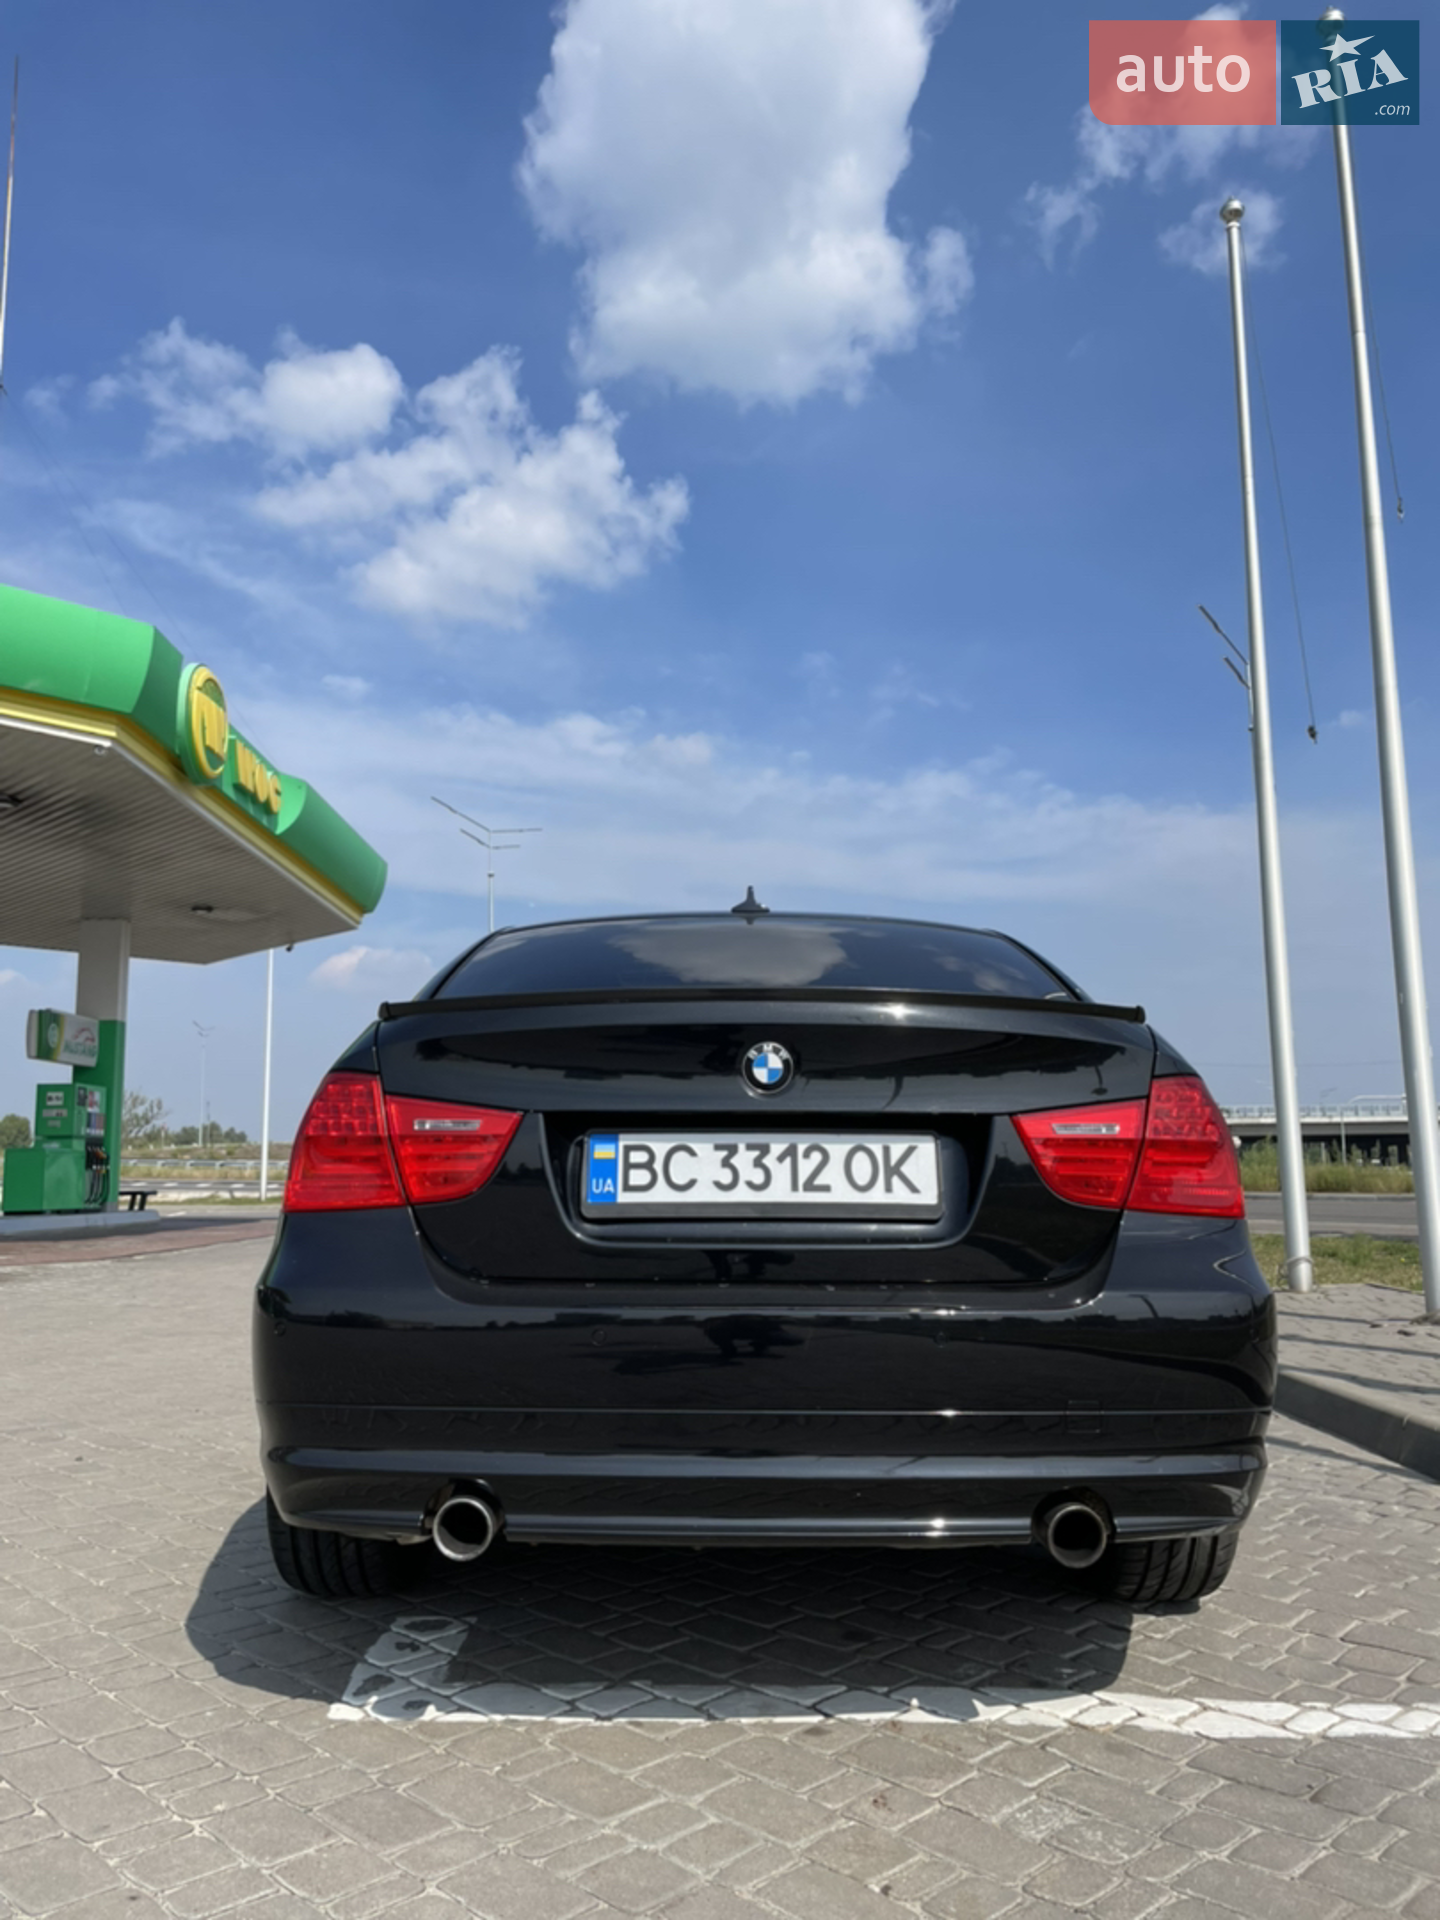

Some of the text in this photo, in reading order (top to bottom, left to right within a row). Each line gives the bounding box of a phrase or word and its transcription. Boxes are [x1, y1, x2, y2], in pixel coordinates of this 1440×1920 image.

[237, 741, 281, 814] WOG
[592, 1178, 615, 1194] UA
[621, 1143, 921, 1194] BC 3312 OK
